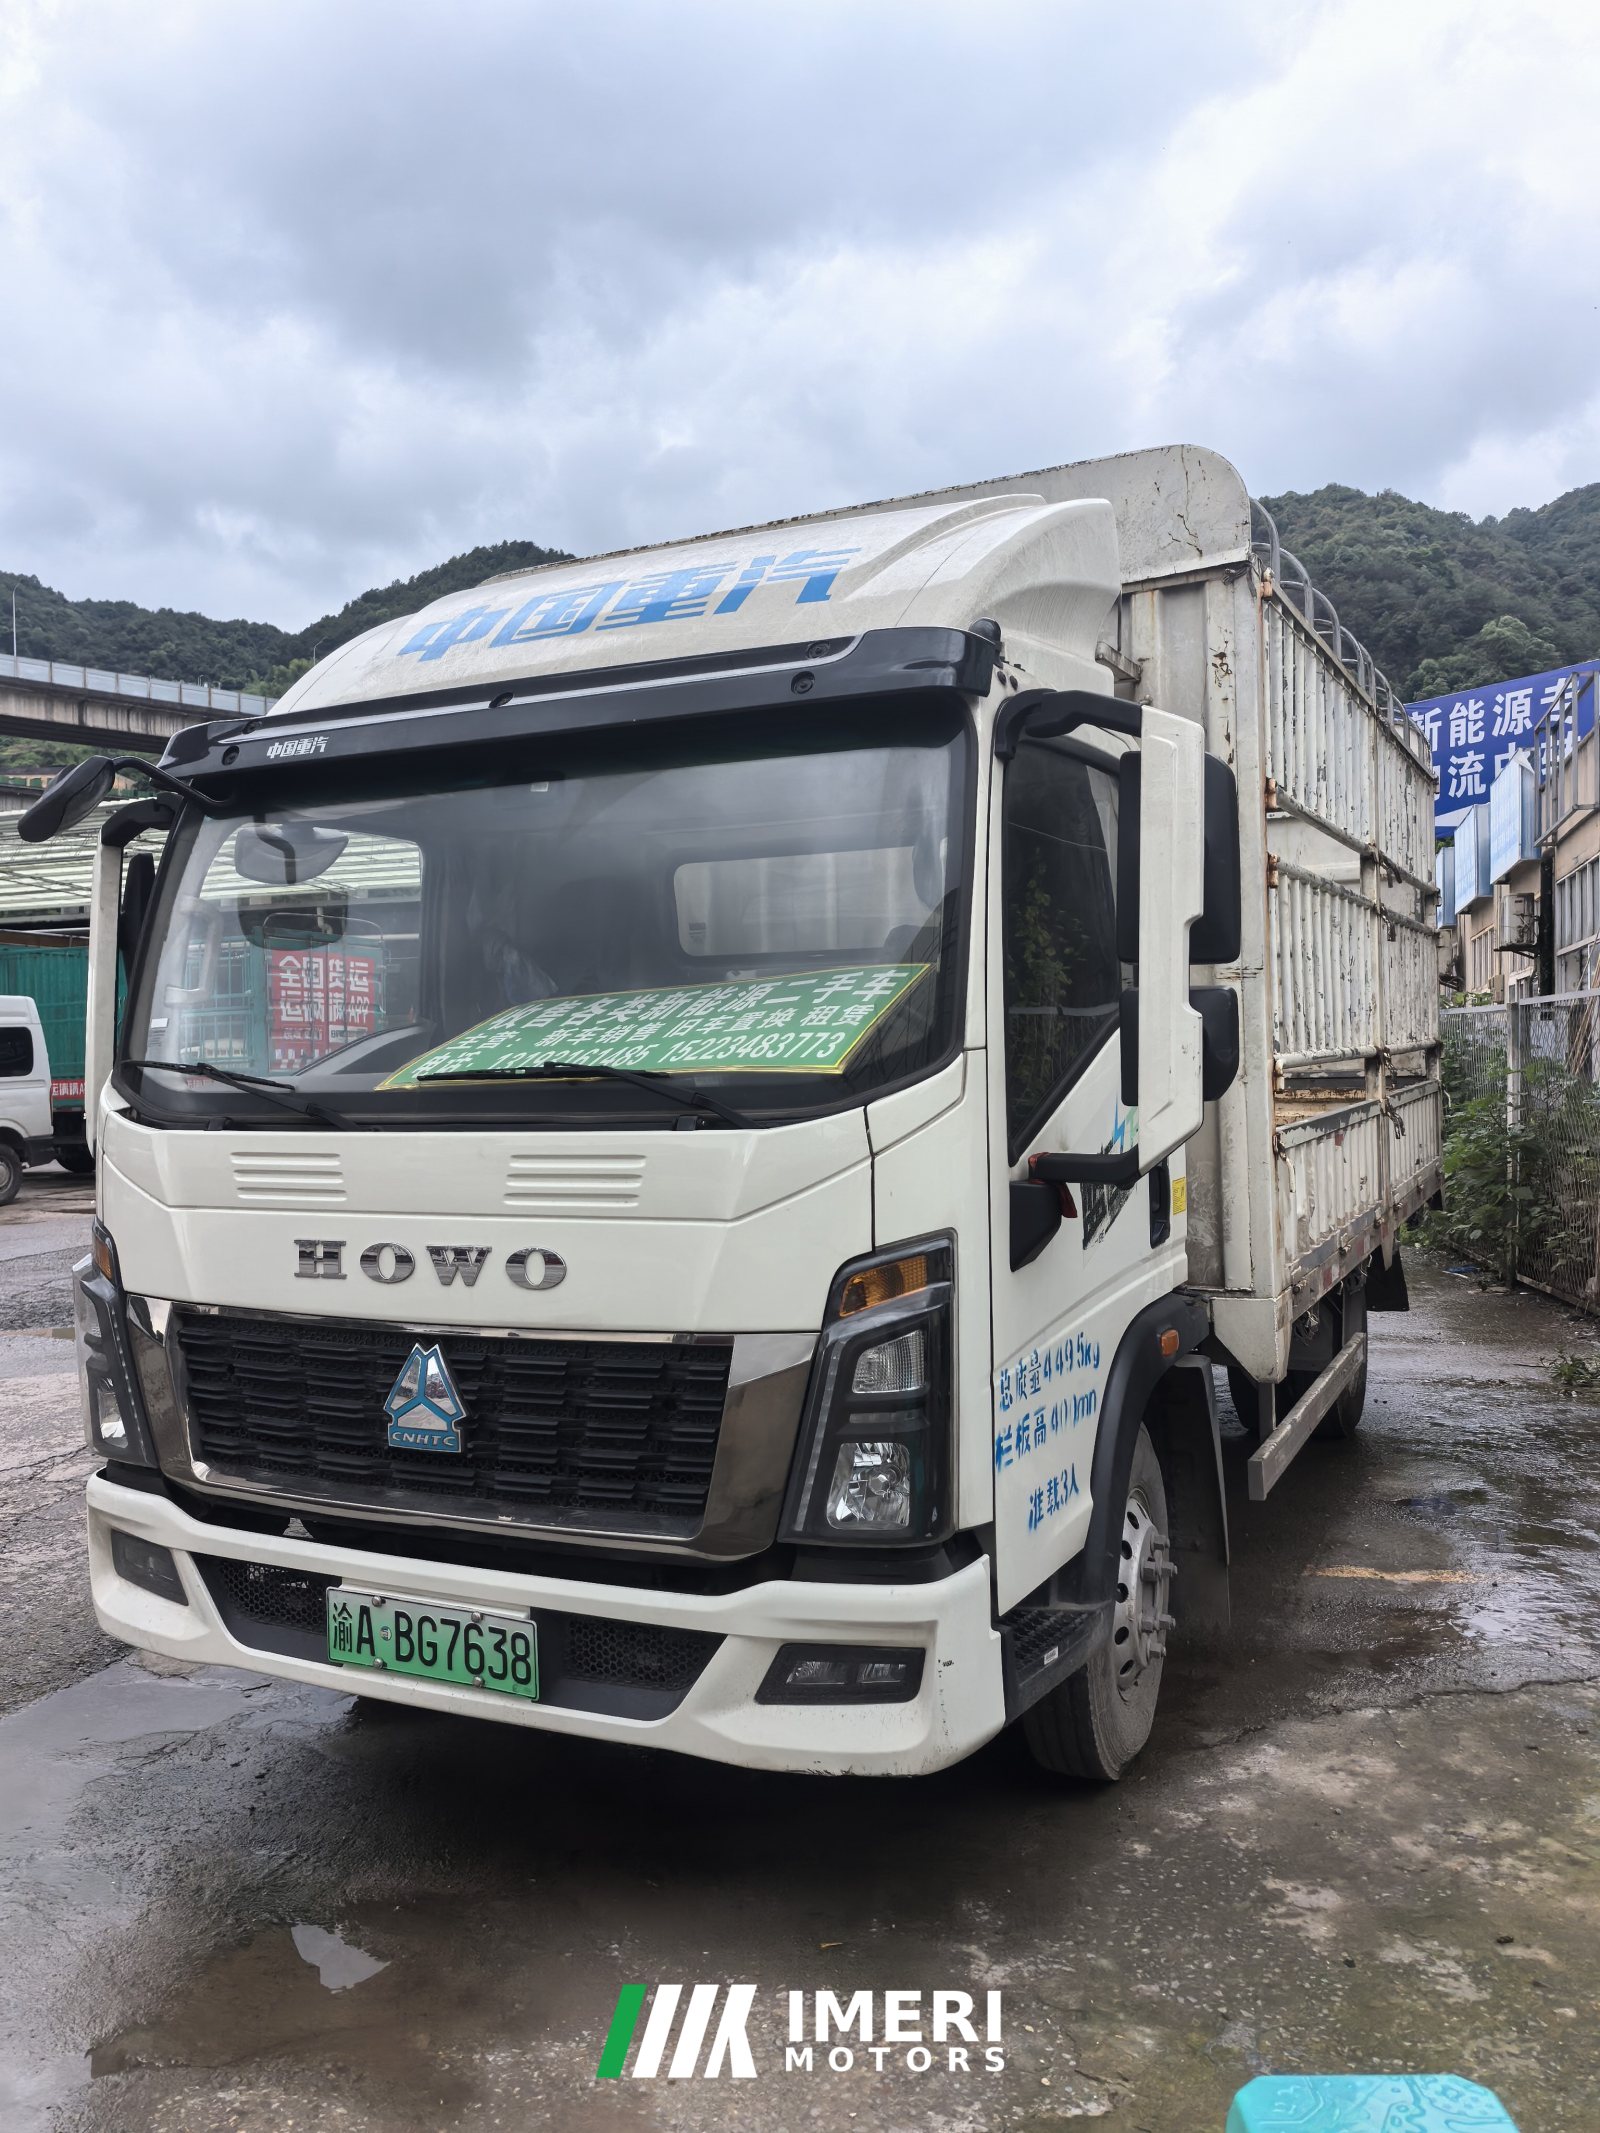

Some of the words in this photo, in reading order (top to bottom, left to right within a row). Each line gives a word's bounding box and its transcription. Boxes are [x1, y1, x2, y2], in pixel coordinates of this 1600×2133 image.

[398, 547, 862, 662] 中国重汽
[267, 736, 330, 759] 中国重汽
[279, 955, 369, 992] 全国货运
[662, 1008, 798, 1038] 旧车置换
[800, 1003, 875, 1028] 租赁
[657, 1032, 846, 1064] 15223483773
[294, 1239, 567, 1290] HOWO
[392, 1432, 456, 1446] CNHTC
